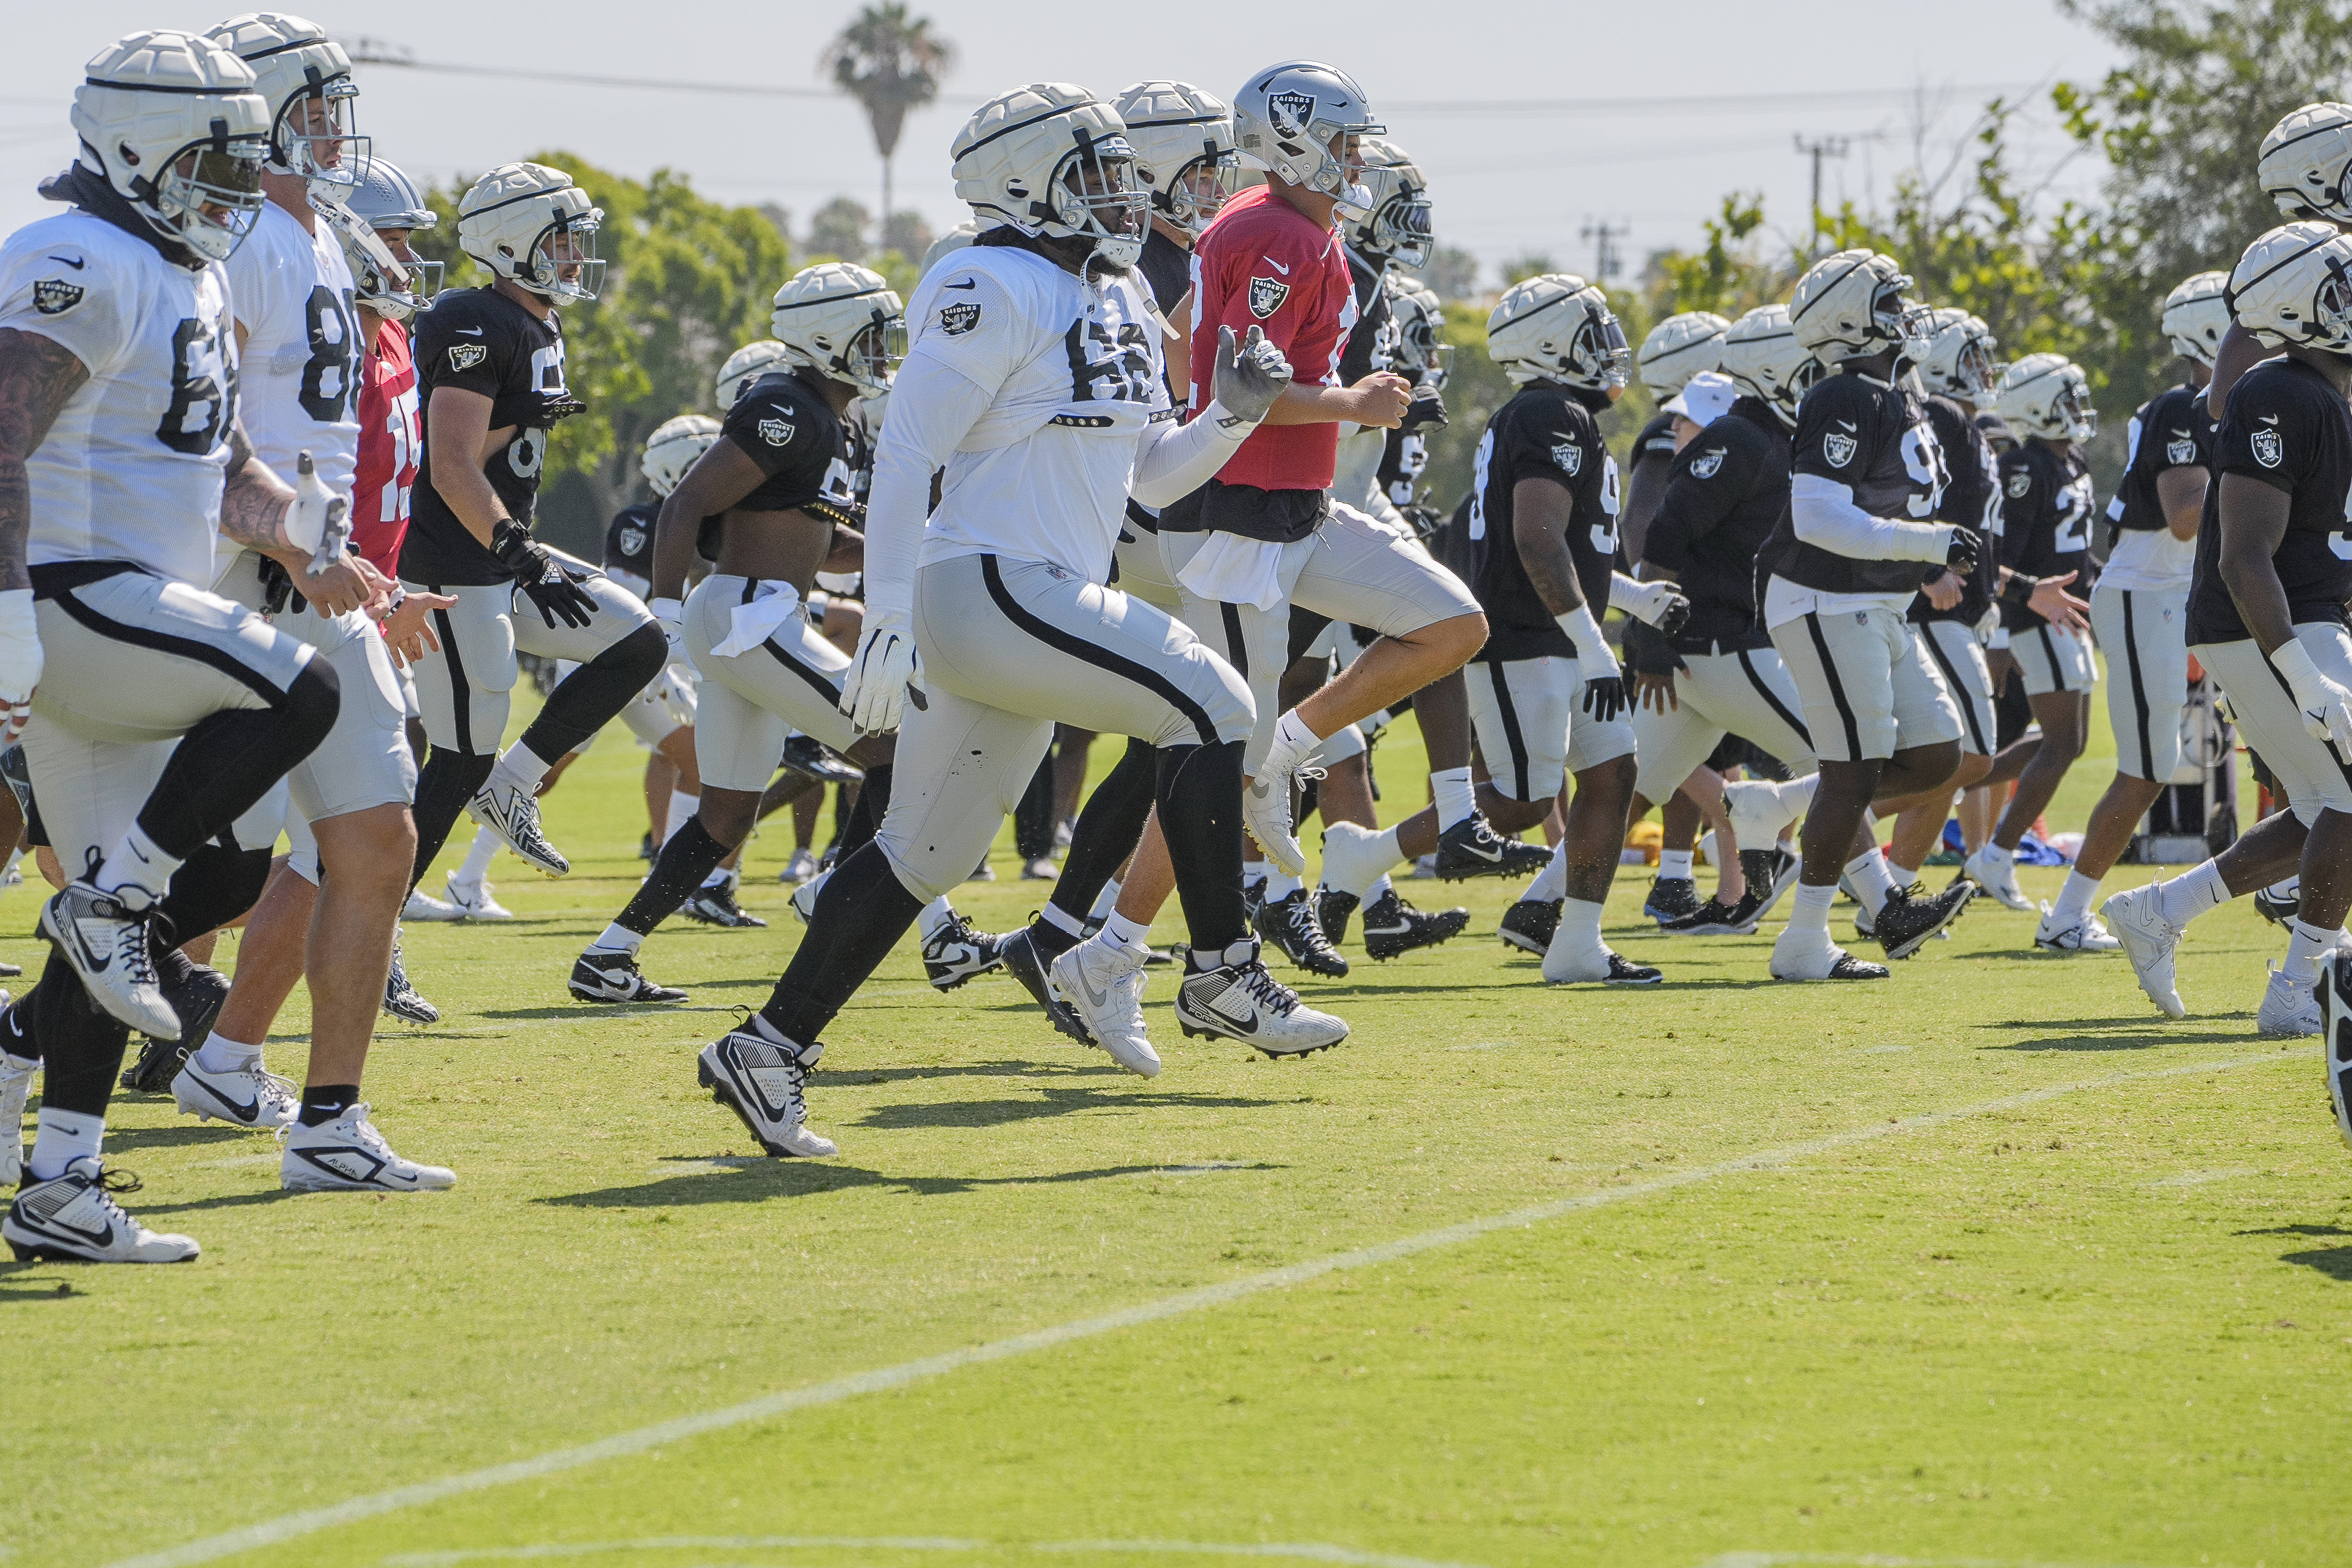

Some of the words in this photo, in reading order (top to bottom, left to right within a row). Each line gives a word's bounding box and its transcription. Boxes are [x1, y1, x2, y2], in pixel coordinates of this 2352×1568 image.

[1255, 280, 1285, 292] RAIDERS
[944, 305, 977, 315] RAIDERS
[1590, 455, 1620, 554] 9
[539, 563, 555, 585] adidas
[1188, 1007, 1225, 1029] FORCE
[327, 1158, 358, 1178] ALPHA
